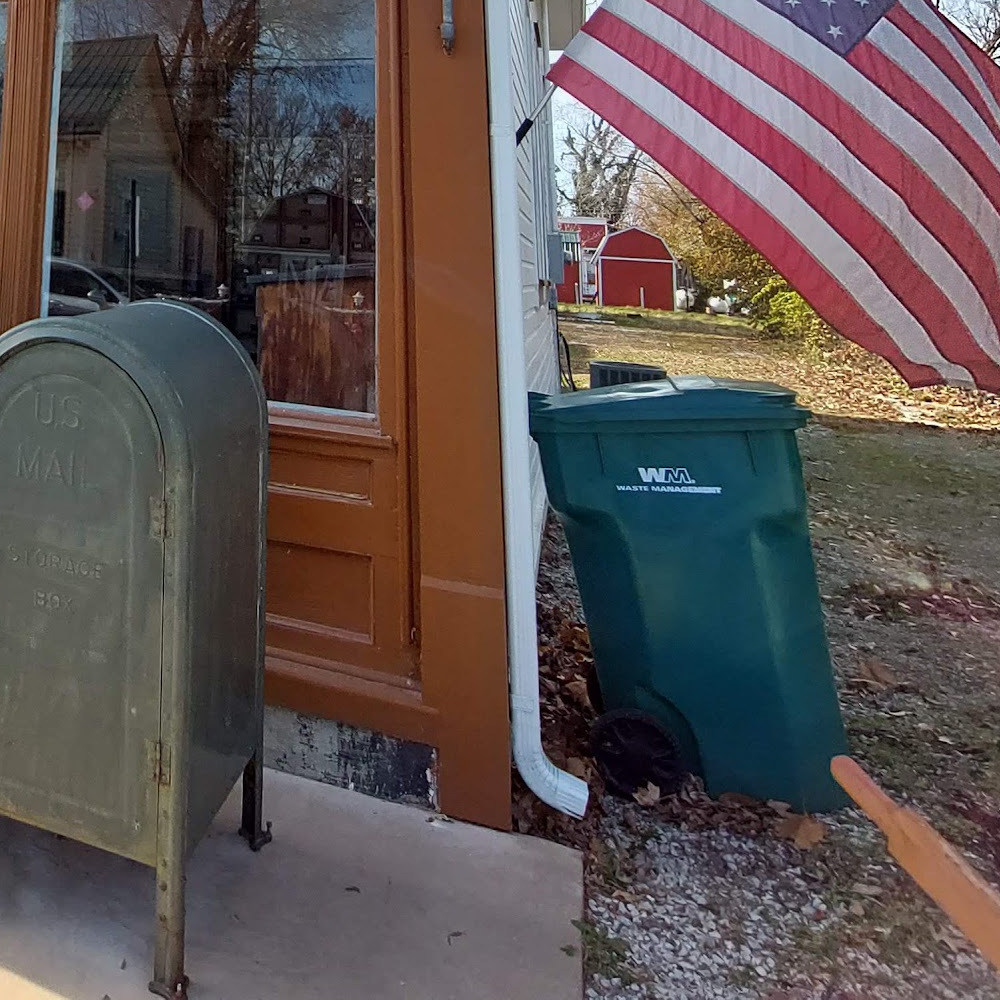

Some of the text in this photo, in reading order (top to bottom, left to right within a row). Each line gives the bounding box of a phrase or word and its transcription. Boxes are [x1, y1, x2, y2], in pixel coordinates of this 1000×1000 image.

[15, 443, 100, 489] MAIL
[651, 485, 722, 494] MANAGEMENT
[7, 544, 102, 580] STORAGE
[33, 589, 74, 611] BOX
